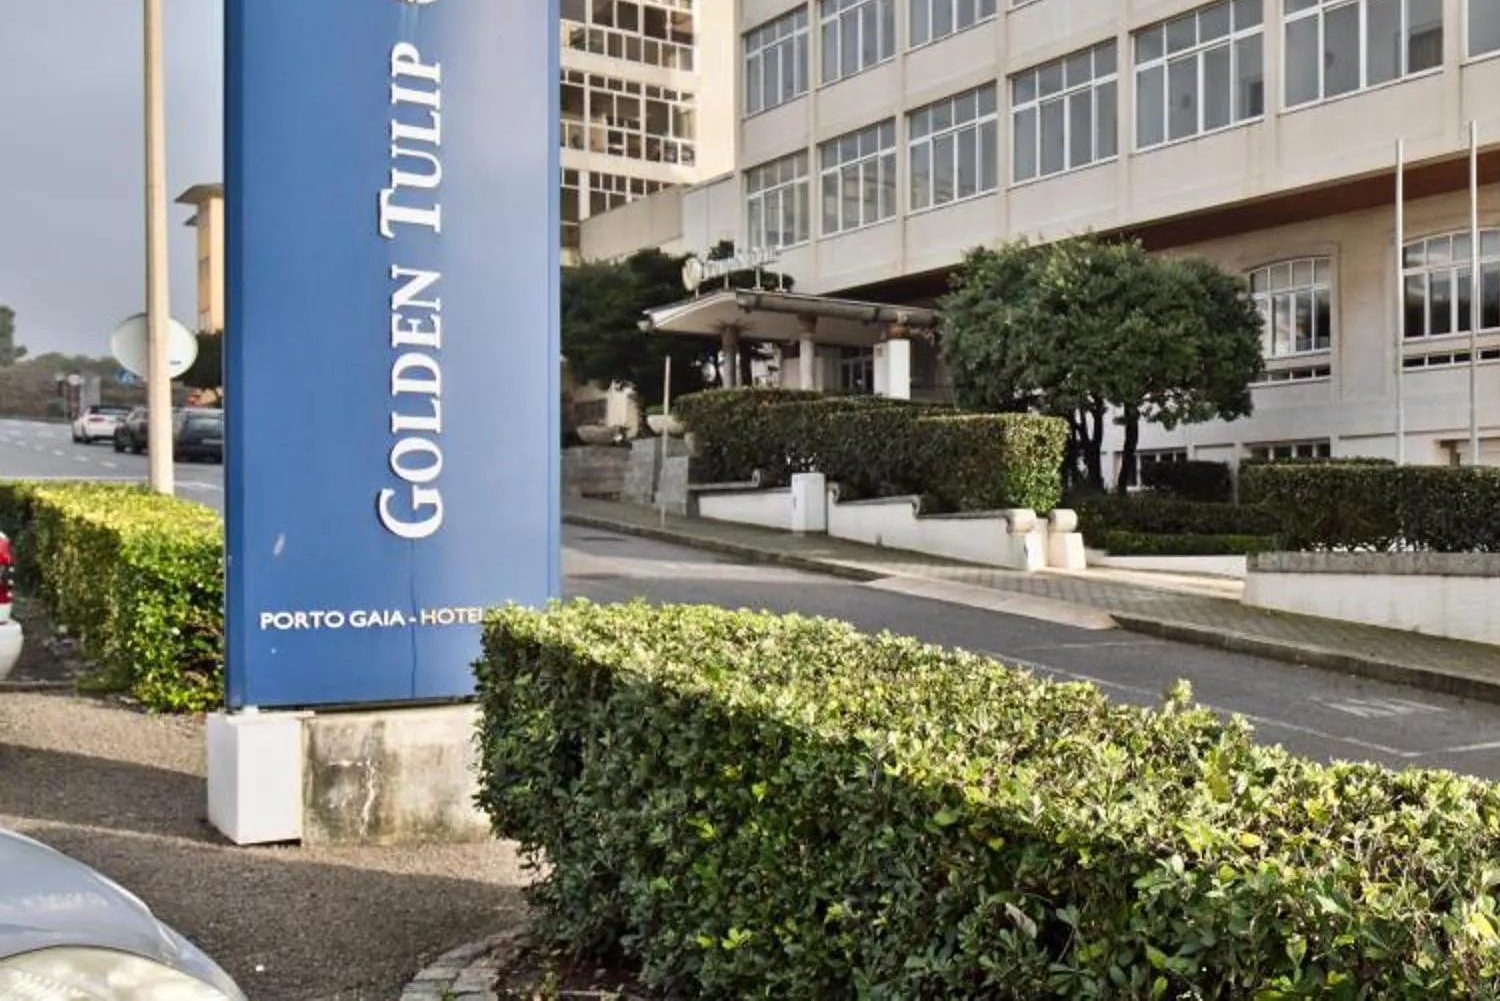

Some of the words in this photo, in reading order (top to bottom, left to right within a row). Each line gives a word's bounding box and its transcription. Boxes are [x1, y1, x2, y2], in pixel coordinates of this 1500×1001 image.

[379, 41, 443, 239] TULIP
[379, 264, 444, 539] GOLDEN
[259, 610, 345, 631] PORTO
[349, 609, 406, 630] GAIA
